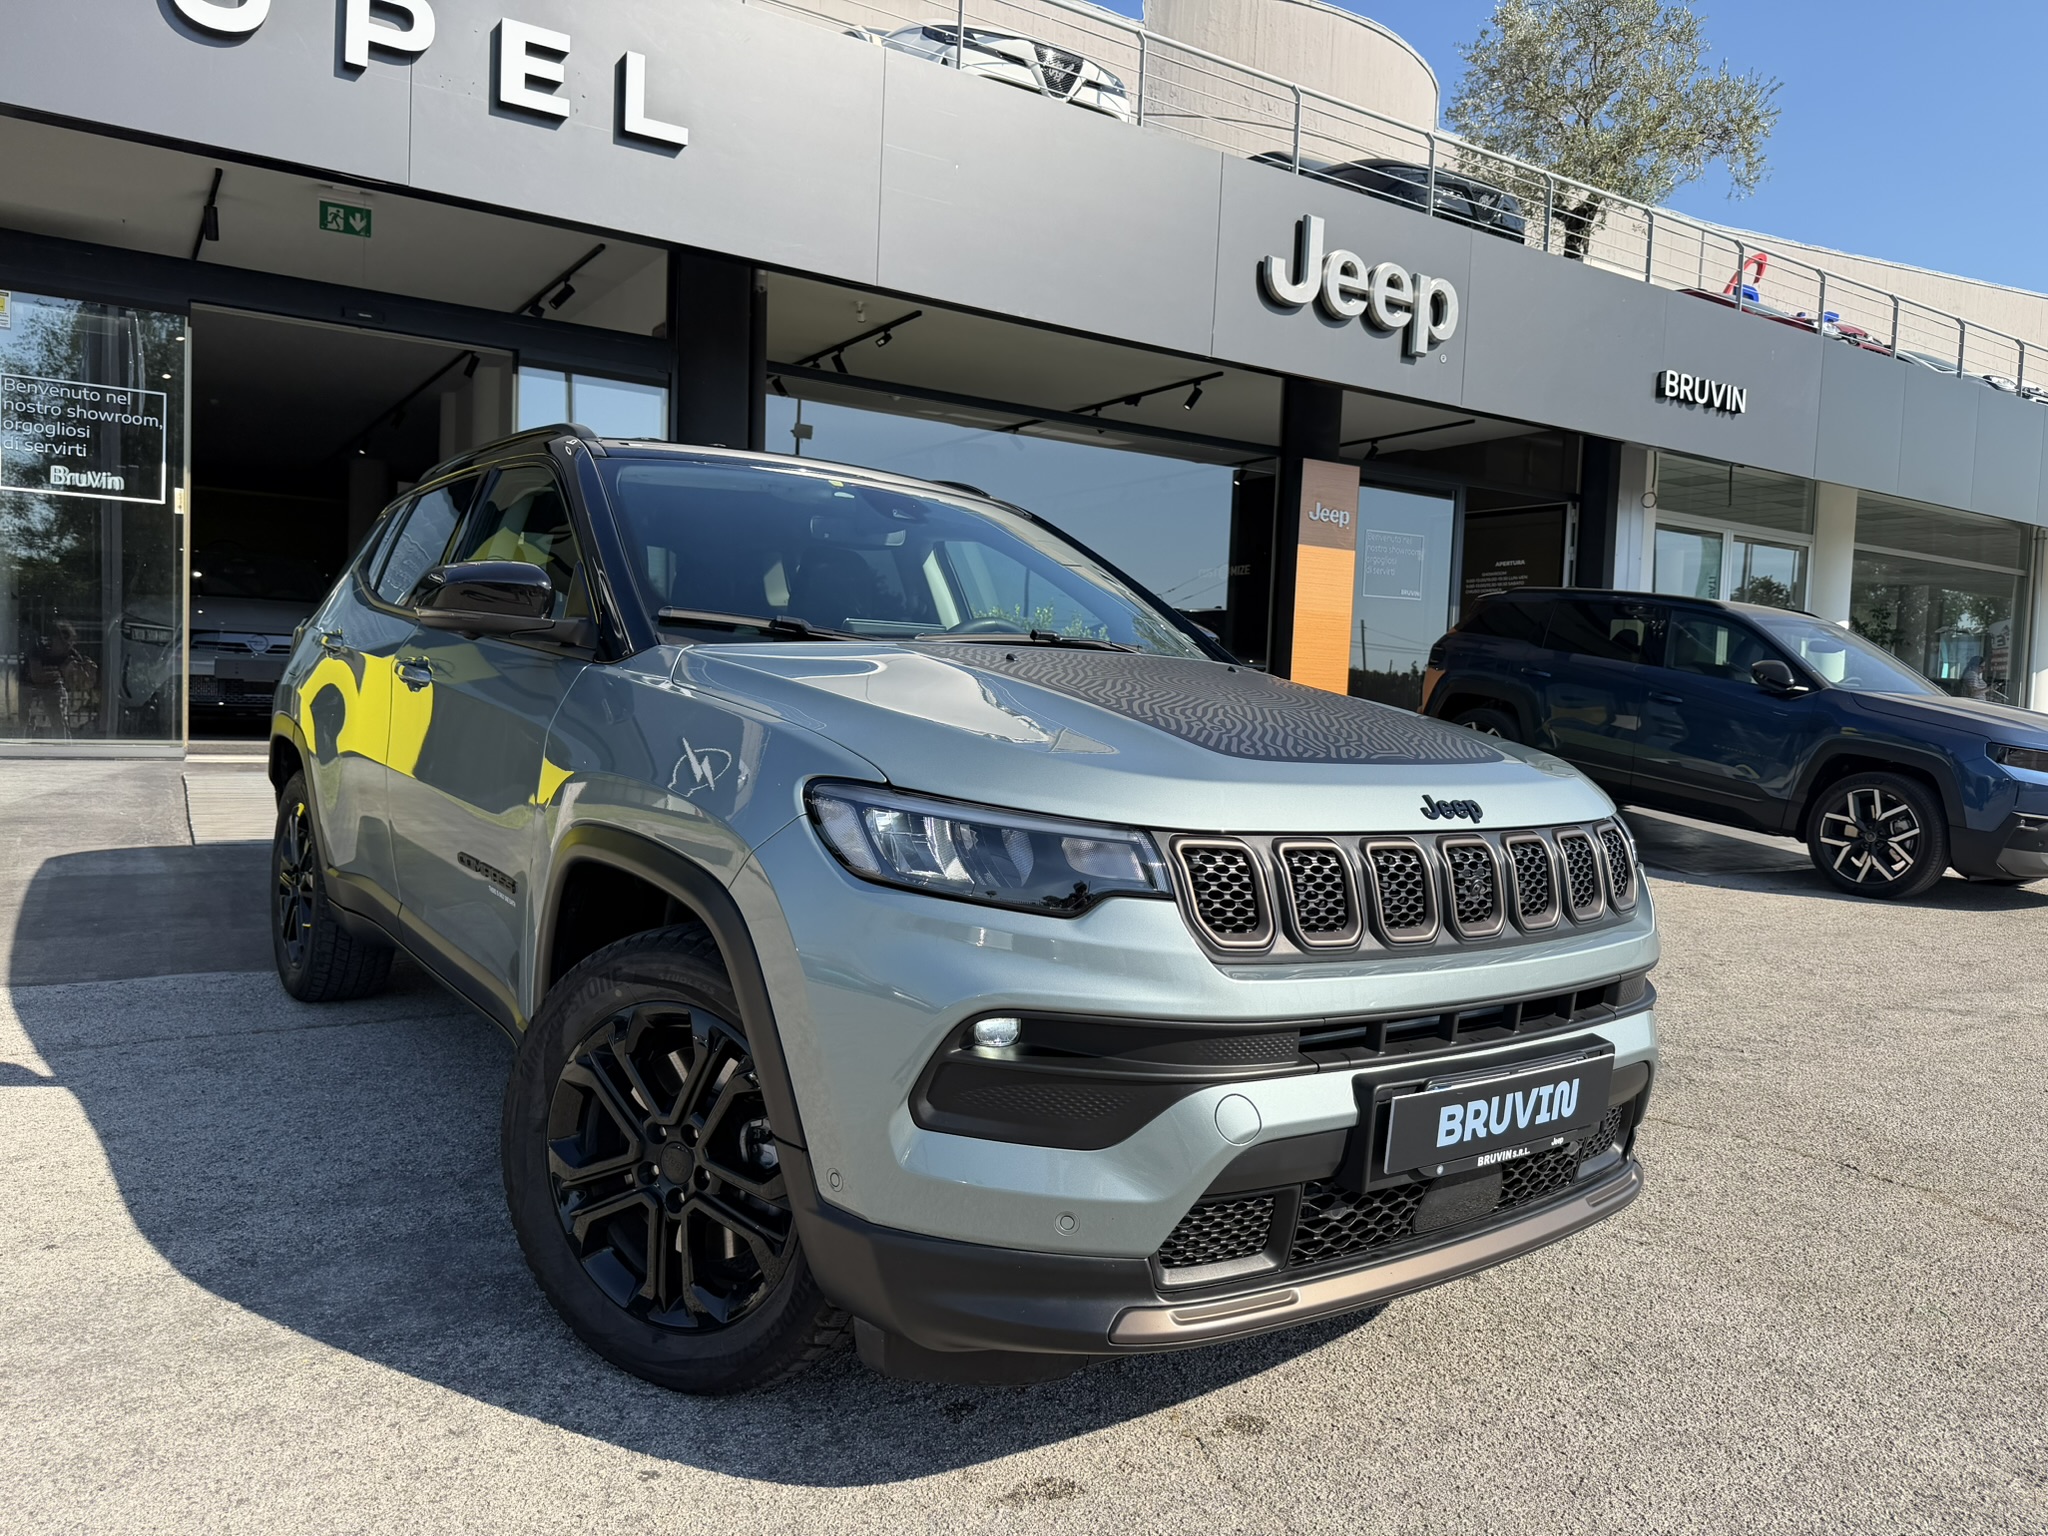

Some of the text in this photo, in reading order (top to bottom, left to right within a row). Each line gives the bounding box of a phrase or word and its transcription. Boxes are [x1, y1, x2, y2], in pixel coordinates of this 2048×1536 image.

[1263, 213, 1459, 358] Jeep
[3, 377, 131, 406] Benvenuto nel
[1663, 369, 1748, 415] BRUVIN
[3, 400, 164, 431] nostro showroom,
[3, 418, 91, 439] orgogliosi
[3, 437, 88, 457] di servirti
[50, 464, 125, 491] BruVin
[1308, 502, 1350, 528] Jeep
[1420, 794, 1484, 824] Jeep
[457, 851, 517, 894] COMPASS
[1436, 1077, 1581, 1148] BRUVIN
[1551, 1136, 1564, 1146] Jeep
[1477, 1148, 1513, 1167] BRUVIN
